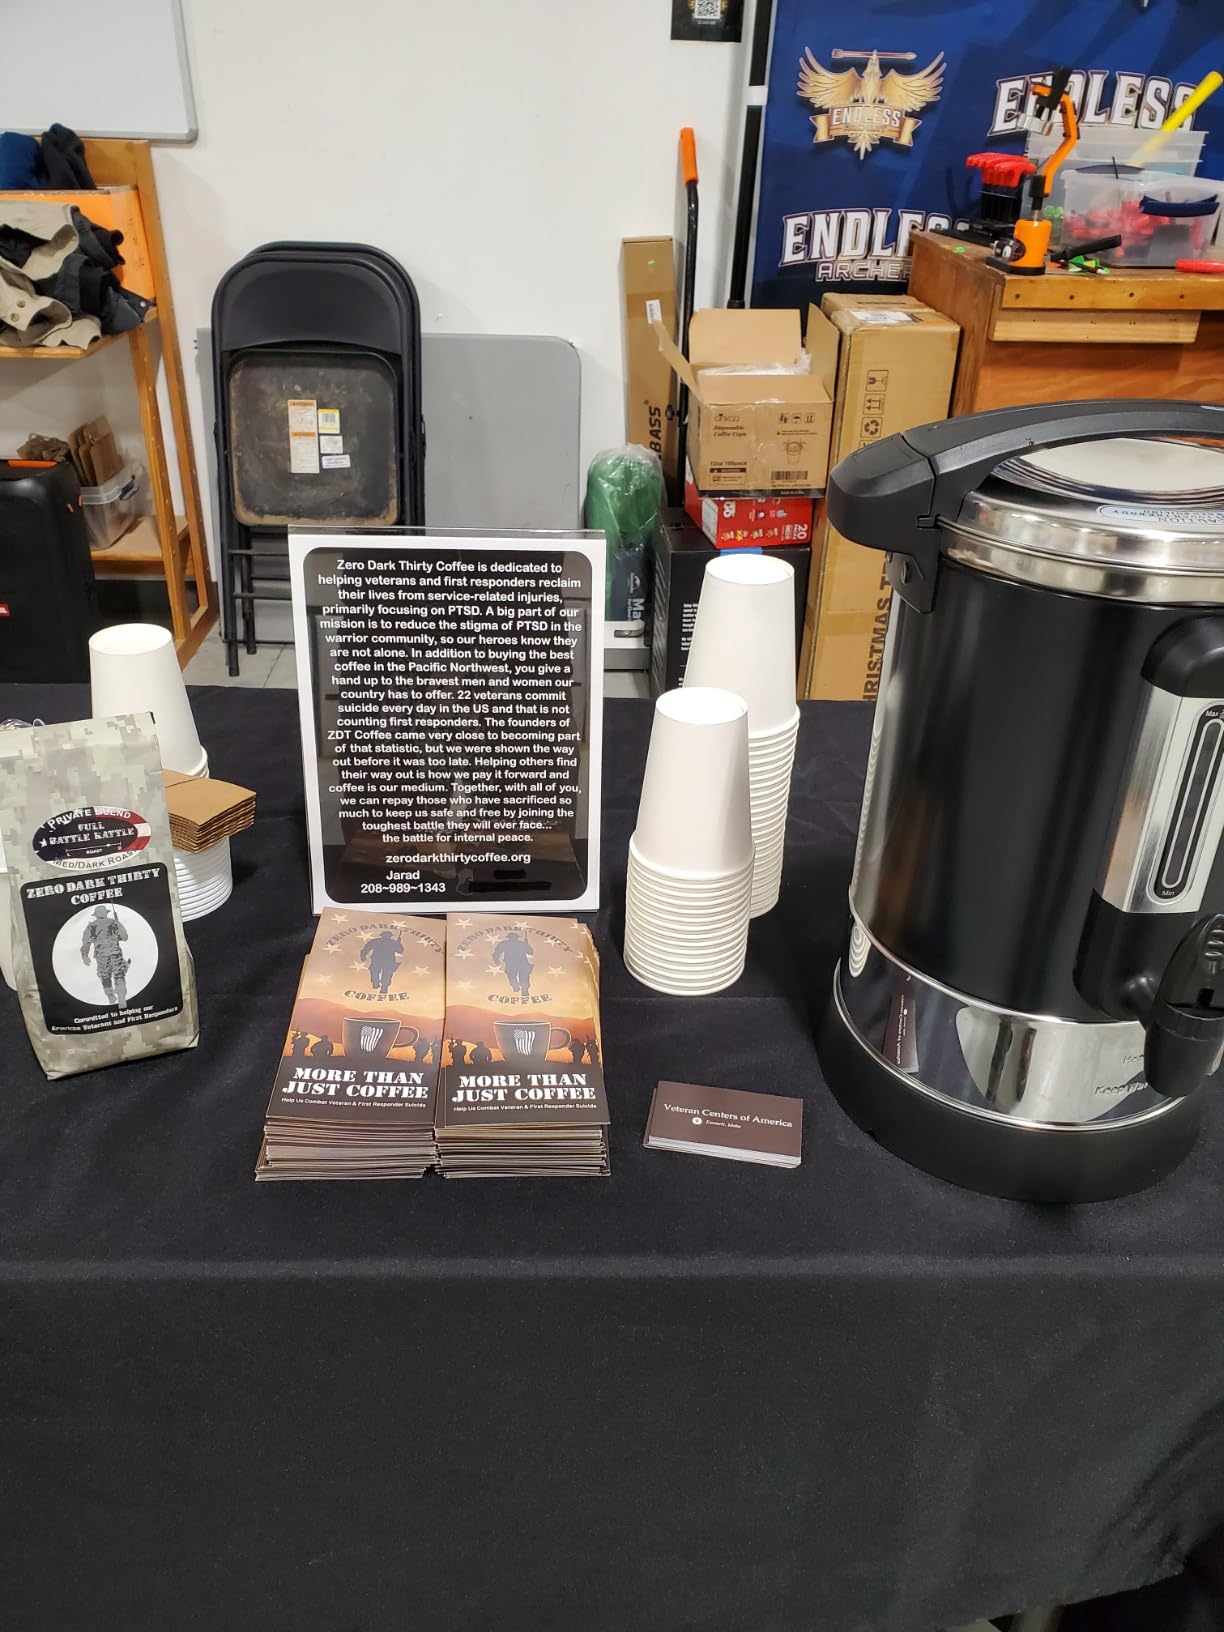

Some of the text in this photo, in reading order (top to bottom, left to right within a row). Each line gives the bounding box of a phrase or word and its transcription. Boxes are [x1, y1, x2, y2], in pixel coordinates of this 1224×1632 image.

[832, 107, 901, 127] ENDLESS
[648, 406, 662, 461] BASS
[336, 559, 562, 573] Zero Dark Thirty Coffee is dedicated to
[318, 574, 581, 589] helping veterans and first responders reclaim
[337, 589, 563, 604] their lives from service-related injuries,
[322, 603, 579, 618] primarily focusing on PTSD. A big part of our
[320, 618, 582, 632] mission is to reduce the stigma of PTSD in the
[325, 632, 578, 648] warrior community, so our heroes know they
[351, 647, 372, 657] not
[374, 647, 409, 657] alone.
[411, 647, 422, 657] In
[424, 647, 472, 658] addition
[473, 648, 486, 658] to
[488, 648, 526, 661] buying
[528, 649, 547, 659] the
[549, 649, 574, 659] best
[334, 660, 371, 671] coffee
[373, 661, 384, 671] in
[386, 661, 406, 671] the
[408, 661, 447, 672] Pacific
[450, 662, 512, 674] Northwest,
[514, 665, 535, 675] you
[537, 663, 561, 675] give
[48, 809, 92, 829] PRIVATE
[78, 821, 105, 831] FULL
[49, 833, 91, 845] BATTLE
[382, 831, 533, 843] the battle for internal peace.
[385, 852, 531, 864] zerodarkthirtycoffee.org
[385, 869, 420, 880] Jarad
[26, 868, 160, 899] ZERO DARK THIRTY
[70, 887, 123, 905] COFFEE
[343, 990, 410, 1001] COFFEE
[487, 993, 553, 1004] COFFEE
[292, 1067, 424, 1084] MORE THAN
[458, 1073, 587, 1088] MORE THAN
[282, 1081, 429, 1099] JUST COFFEE
[451, 1087, 596, 1102] JUST COFFEE
[663, 1103, 700, 1115] Veteran
[701, 1109, 738, 1120] Centers
[752, 1115, 793, 1128] America
